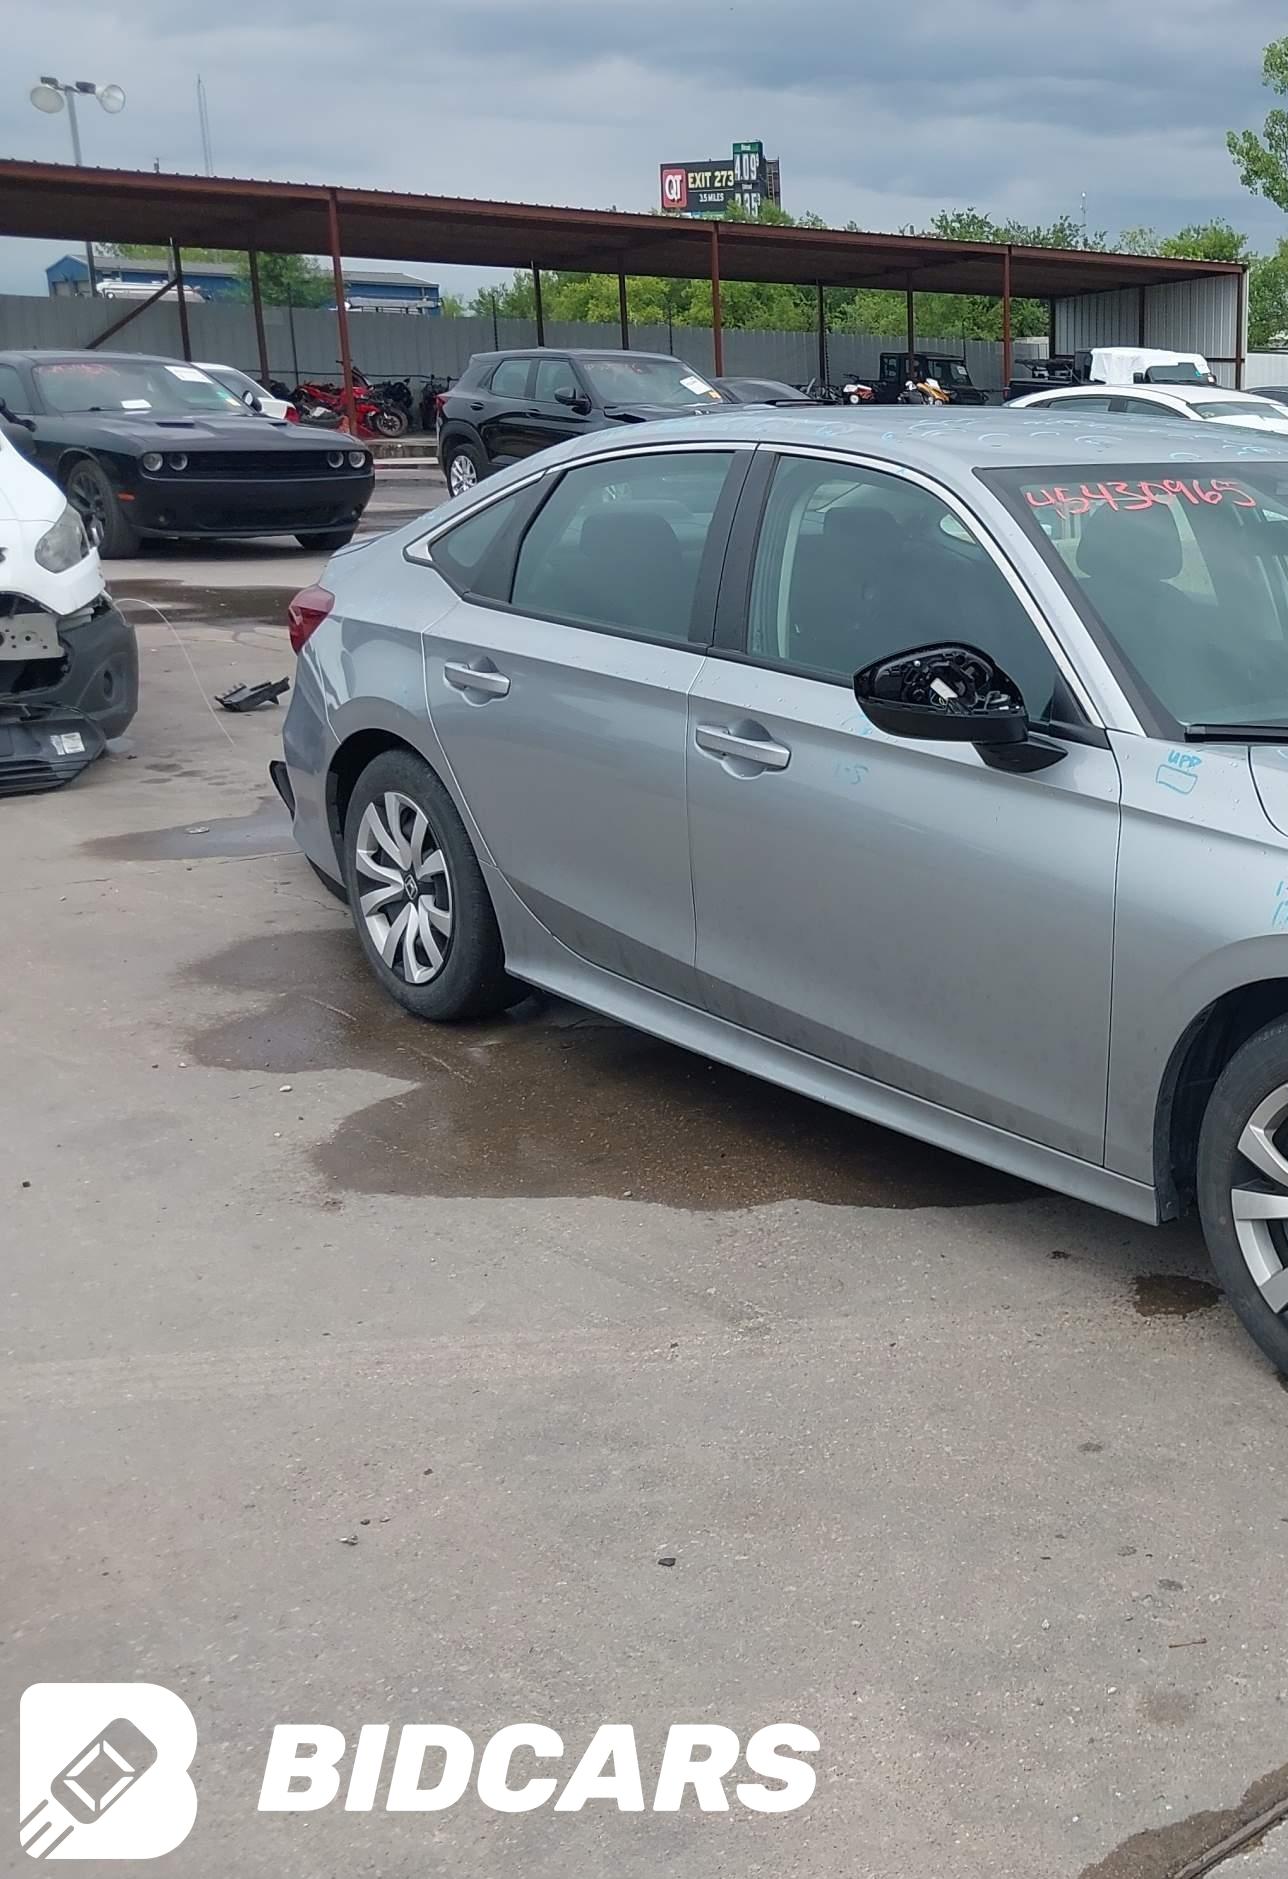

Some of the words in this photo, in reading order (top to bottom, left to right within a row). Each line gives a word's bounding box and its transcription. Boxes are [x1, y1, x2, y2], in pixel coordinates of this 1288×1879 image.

[665, 174, 682, 200] QT
[688, 172, 712, 189] EXIT
[714, 170, 734, 188] 273
